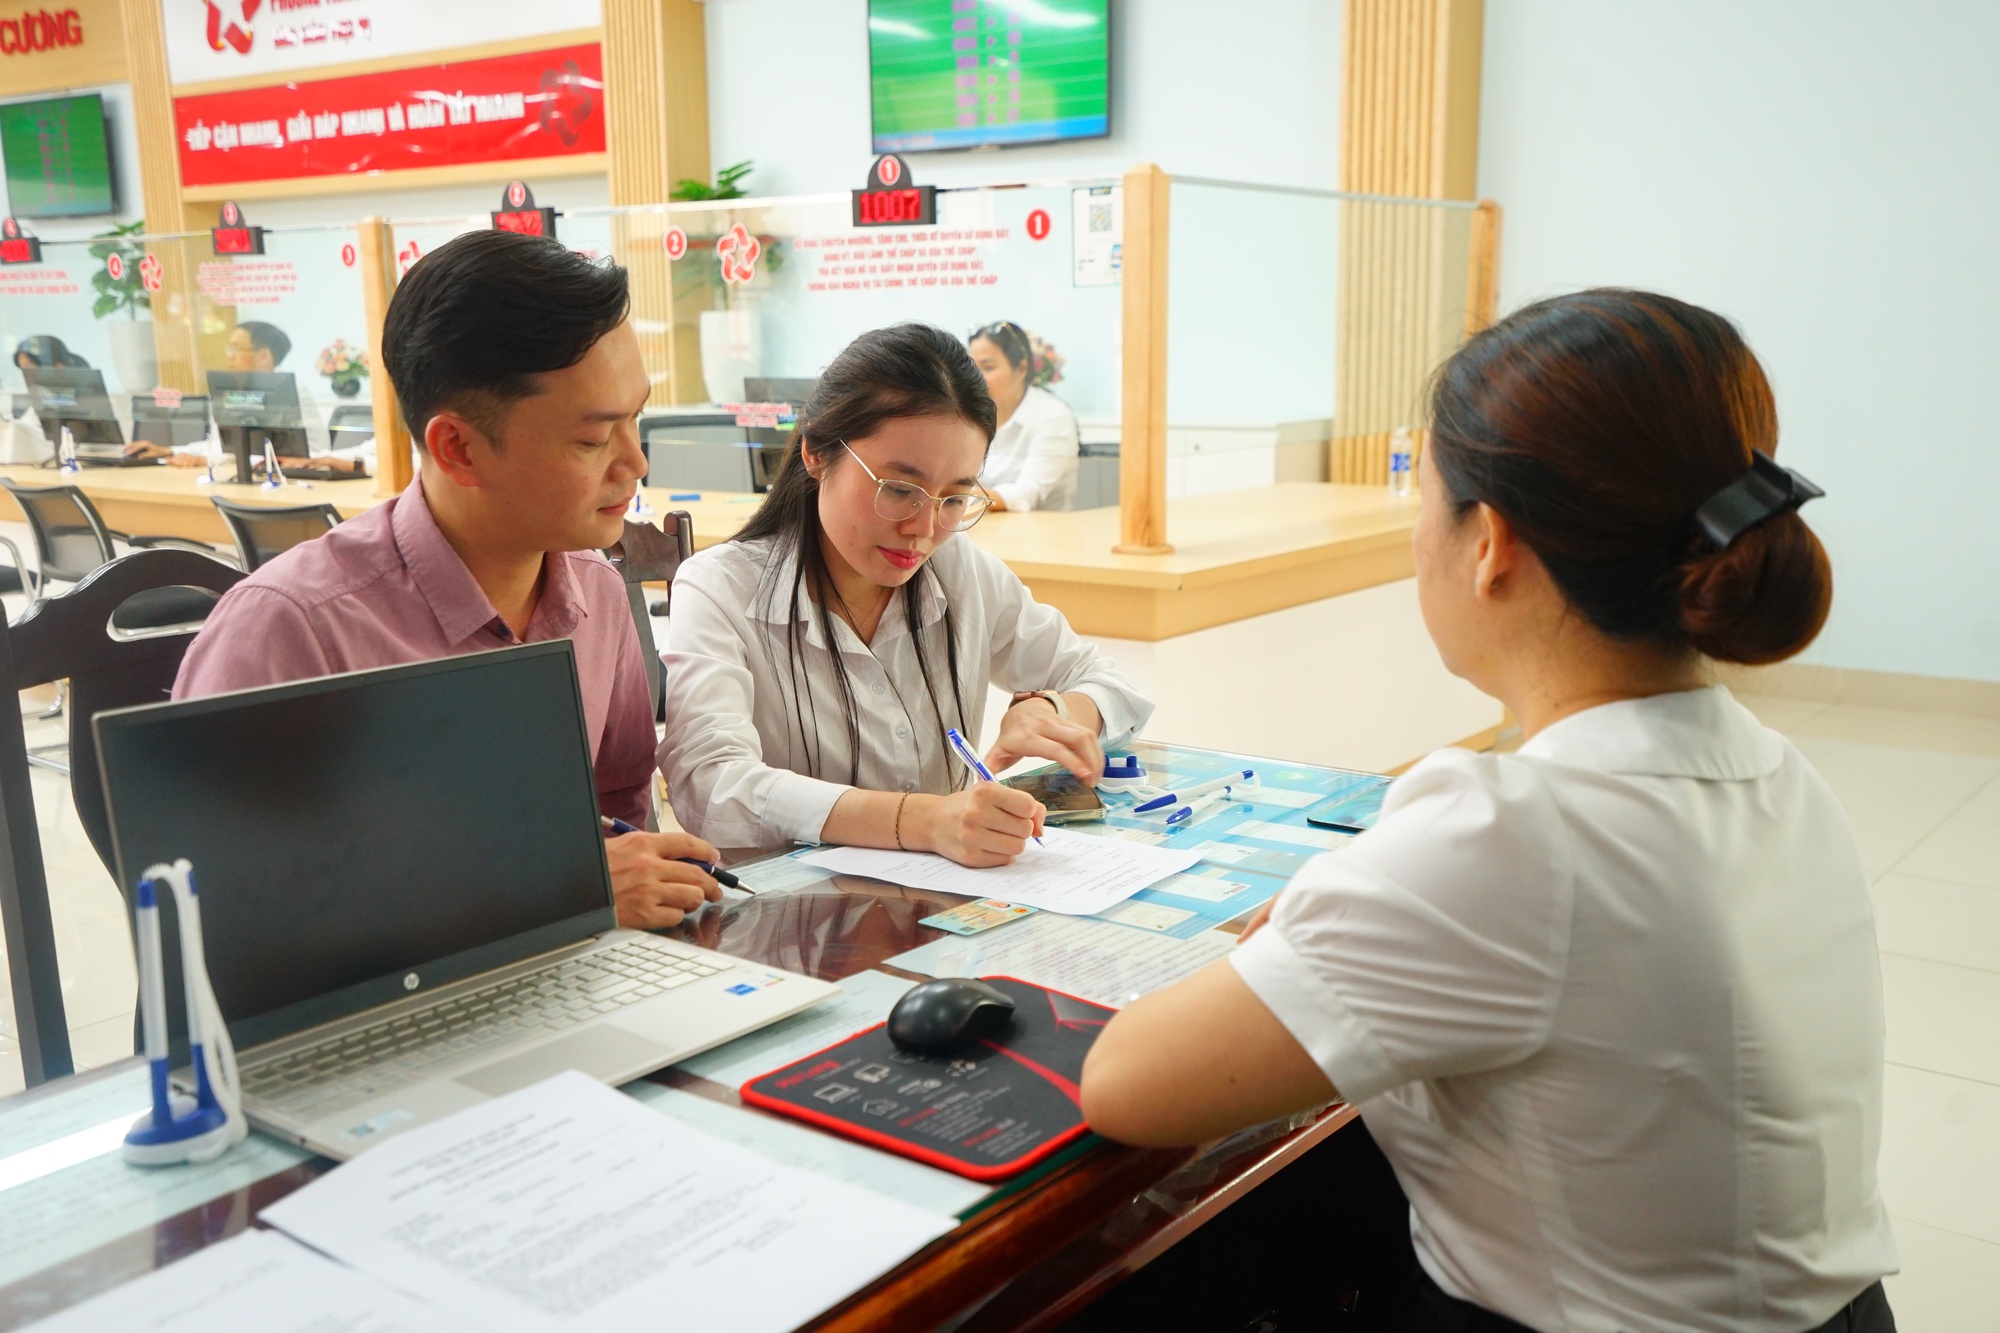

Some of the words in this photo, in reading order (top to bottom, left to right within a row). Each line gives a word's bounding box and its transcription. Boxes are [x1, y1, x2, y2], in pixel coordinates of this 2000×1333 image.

[884, 160, 893, 182] 1
[860, 188, 920, 224] 1007
[1034, 214, 1043, 236] 1
[669, 232, 679, 253] 2
